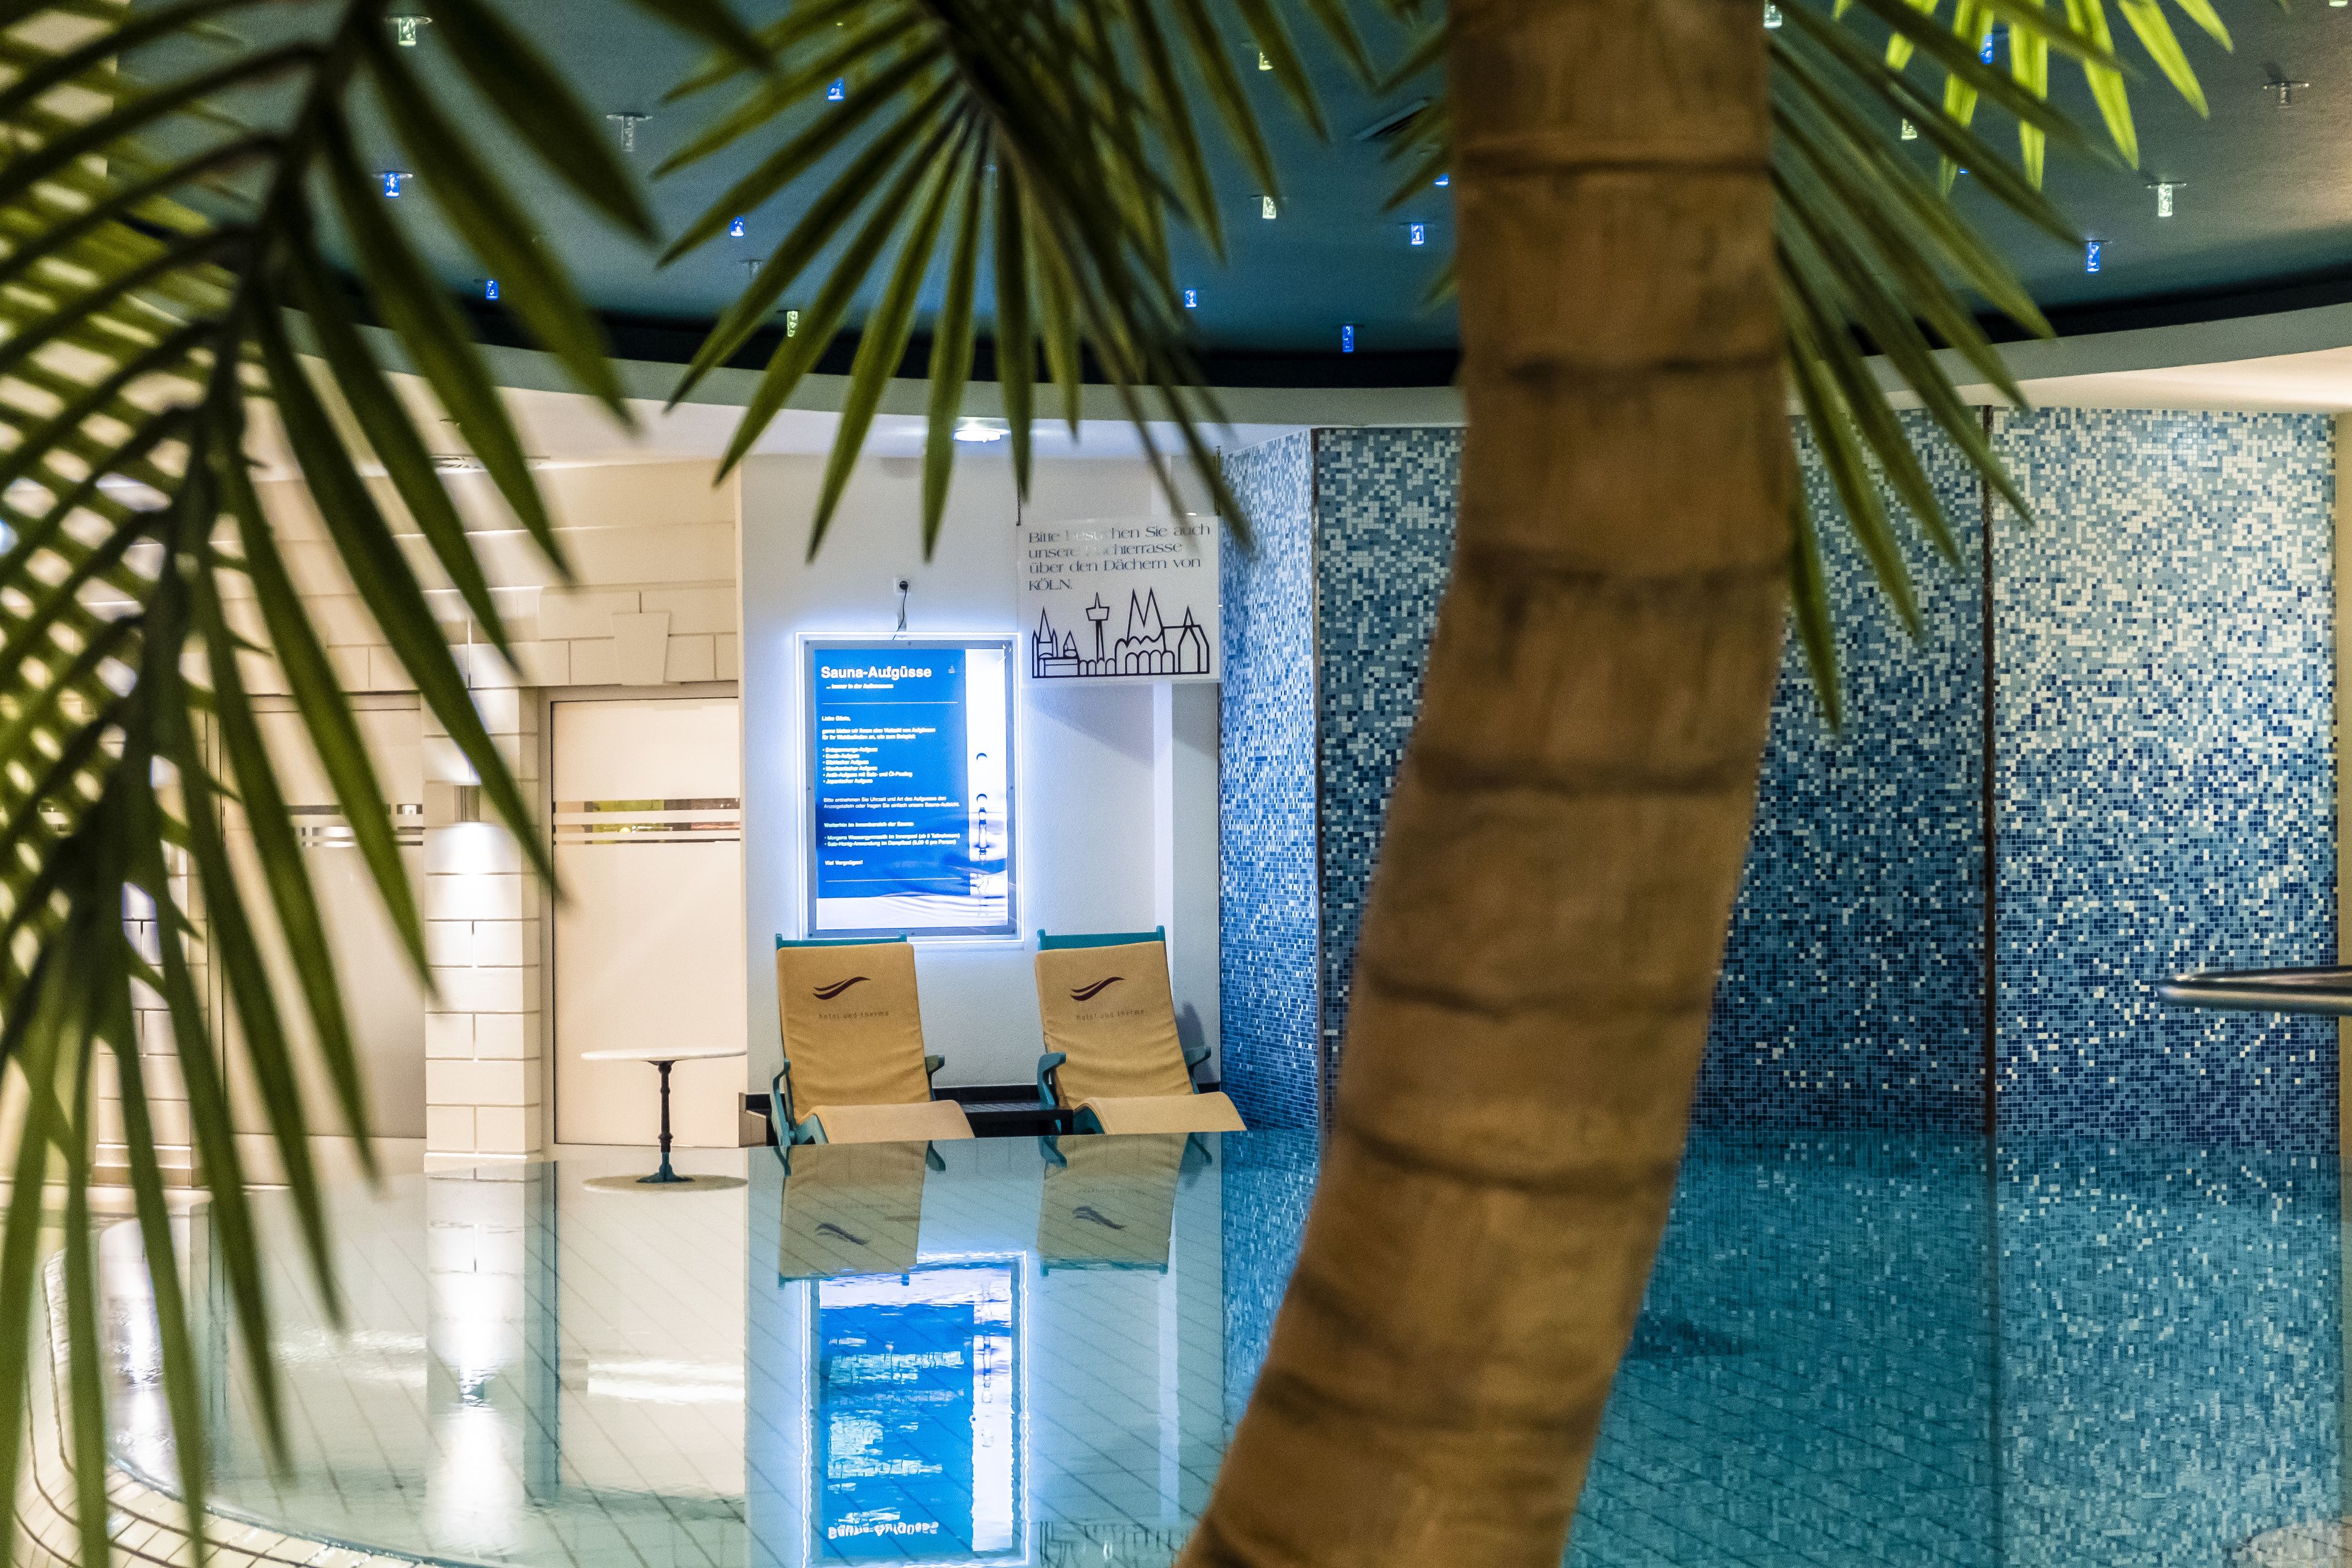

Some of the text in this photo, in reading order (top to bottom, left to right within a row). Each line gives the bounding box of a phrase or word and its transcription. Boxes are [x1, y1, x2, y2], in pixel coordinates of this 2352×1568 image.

[1029, 524, 1210, 543] Bitte esuhen Sie auch
[1028, 543, 1183, 559] unsere chterrasse
[1029, 556, 1201, 574] über den Dächern von
[821, 666, 932, 680] Sauna-Aufgüsse
